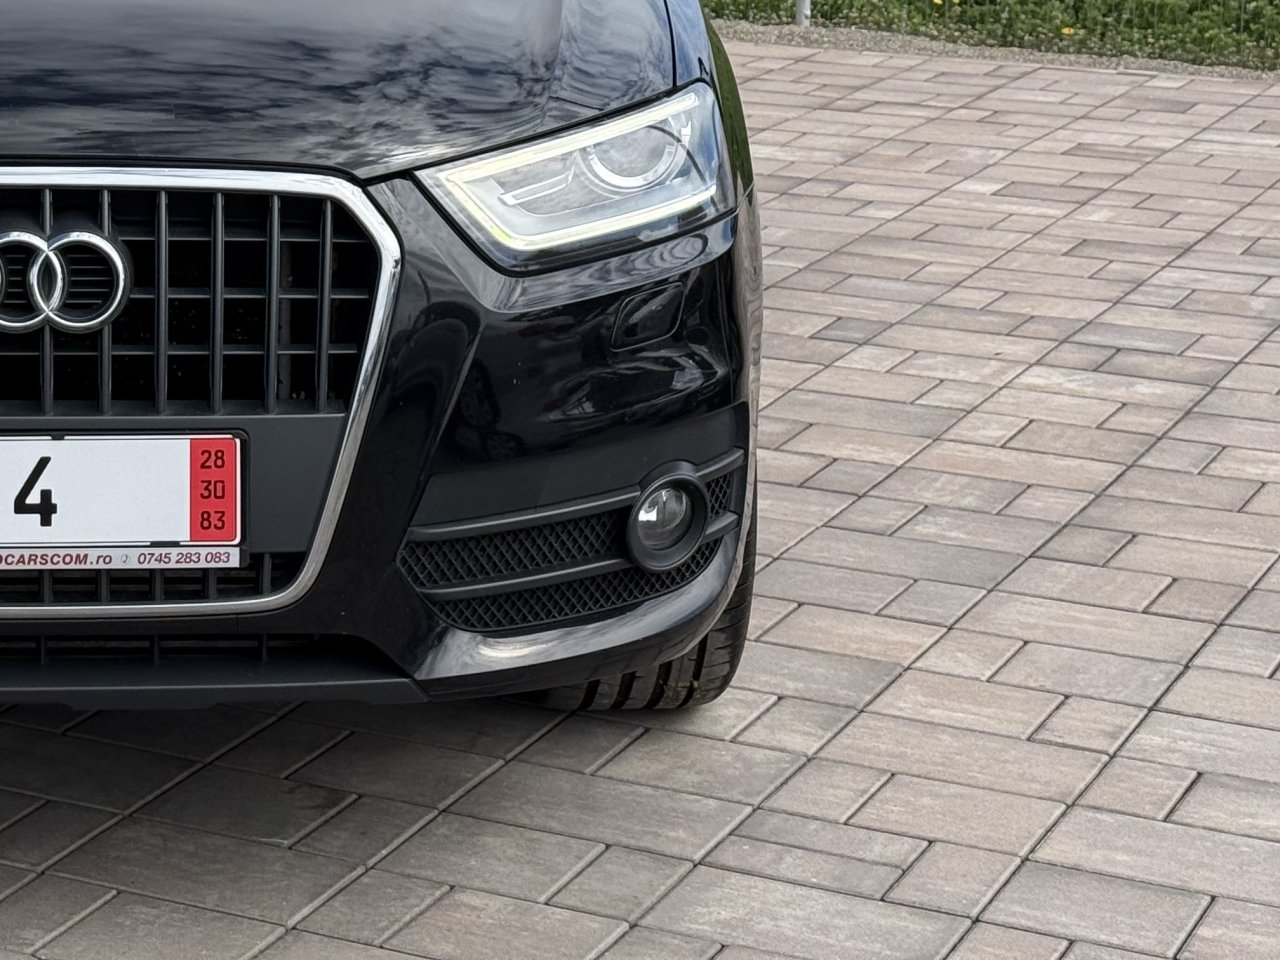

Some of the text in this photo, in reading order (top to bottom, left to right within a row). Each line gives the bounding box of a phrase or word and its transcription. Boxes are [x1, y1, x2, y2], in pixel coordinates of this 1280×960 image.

[199, 449, 225, 470] 28
[14, 456, 58, 527] 4
[199, 480, 226, 500] 30
[199, 510, 226, 531] 83
[137, 552, 172, 565] 0745
[175, 551, 201, 564] 283
[204, 551, 231, 564] 083
